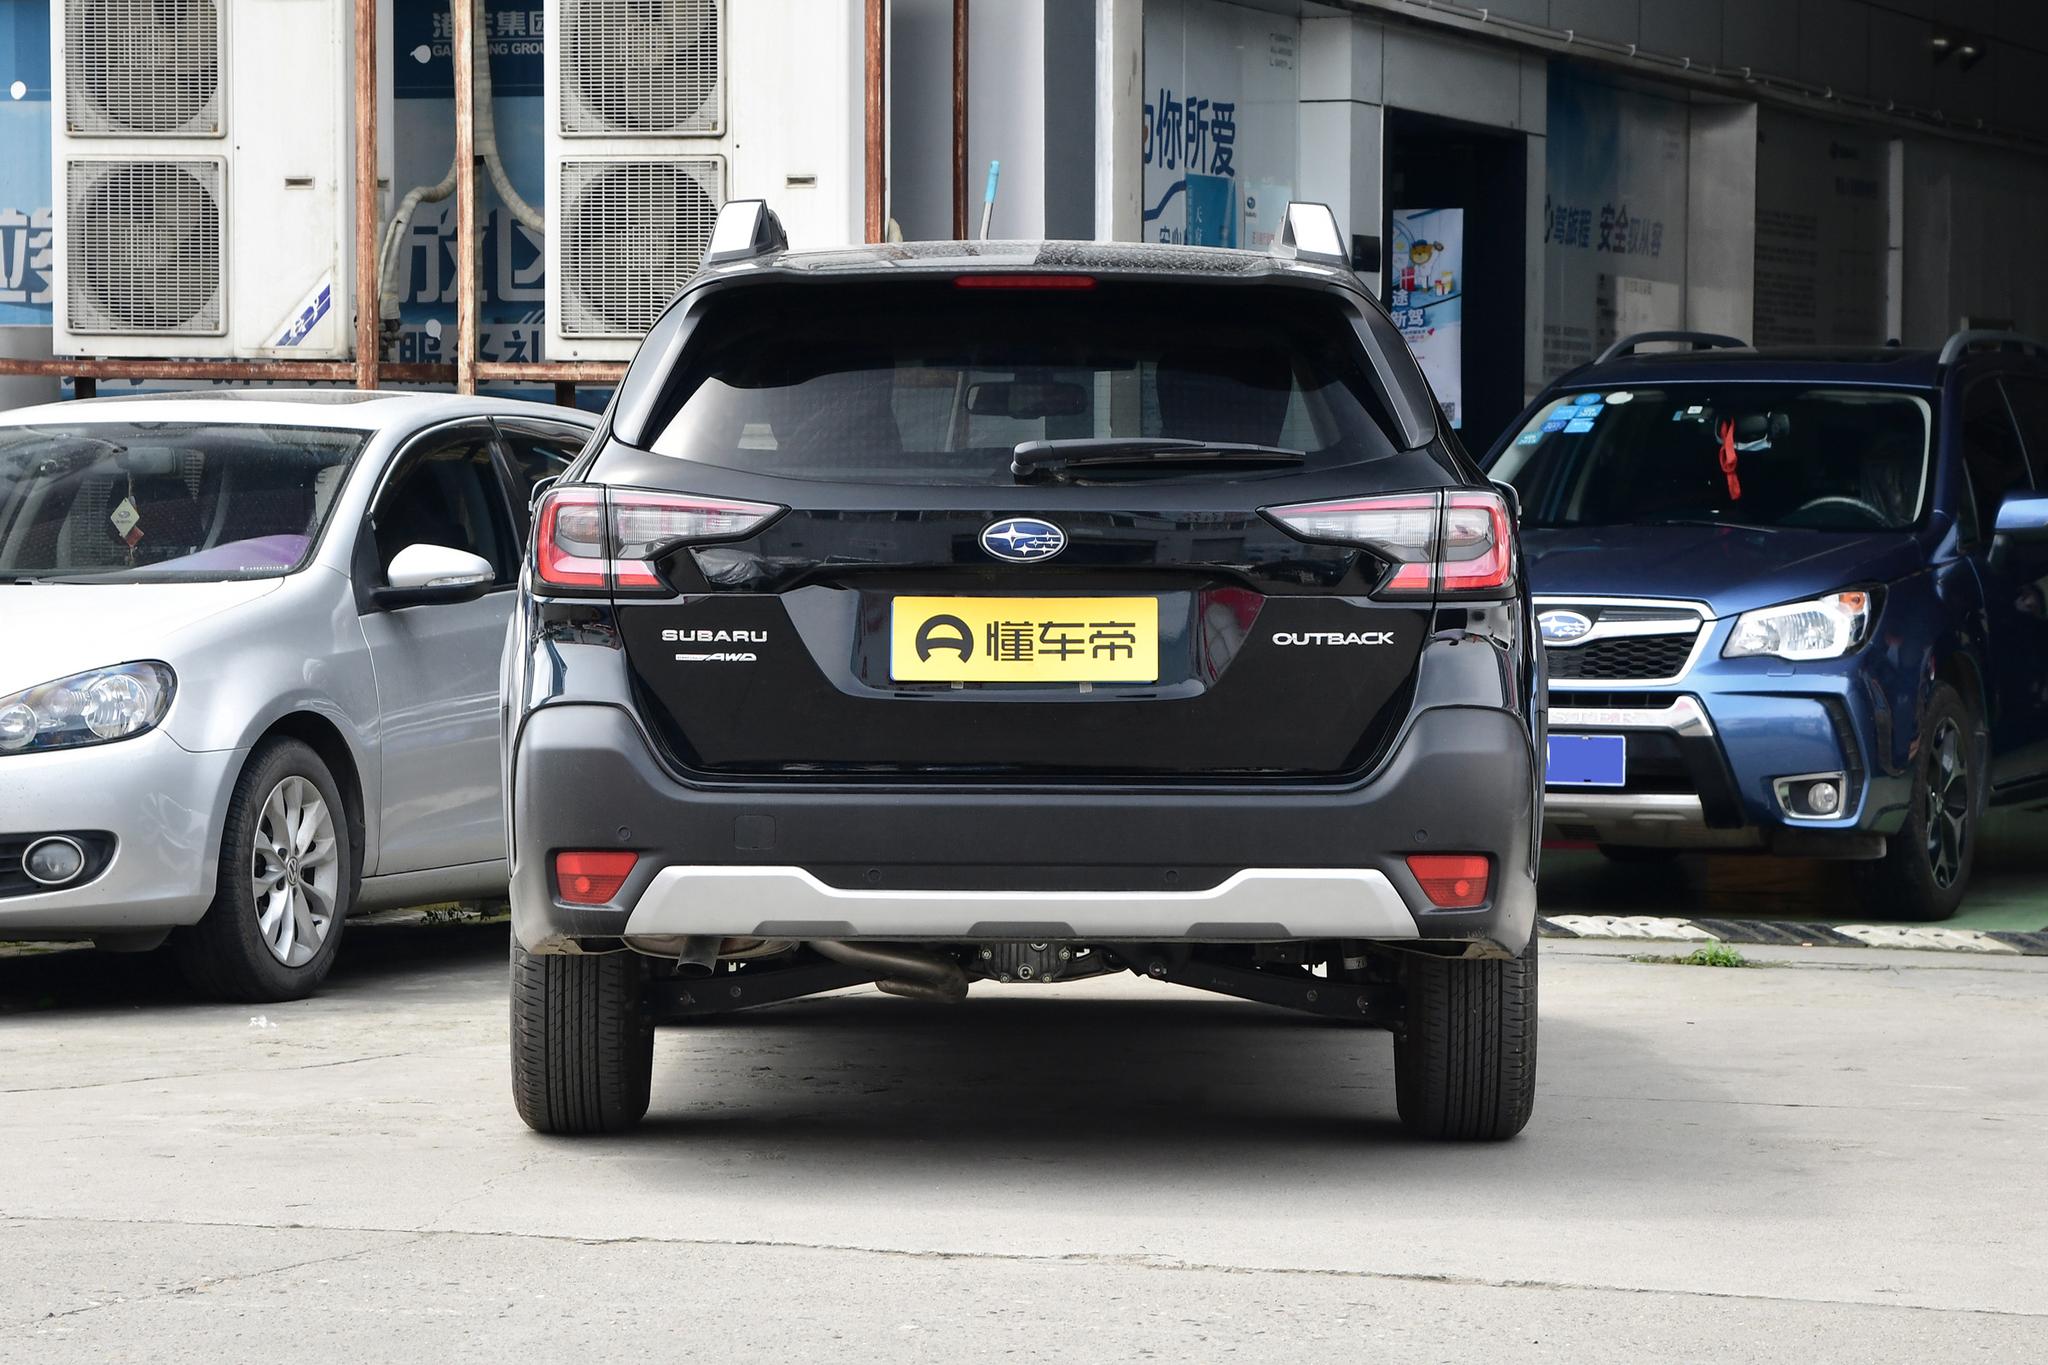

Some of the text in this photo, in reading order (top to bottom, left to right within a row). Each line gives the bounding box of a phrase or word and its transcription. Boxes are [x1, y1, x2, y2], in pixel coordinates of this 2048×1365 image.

[662, 629, 768, 642] SUBARU
[1272, 632, 1394, 645] OUTBACK
[705, 652, 757, 661] AWD
